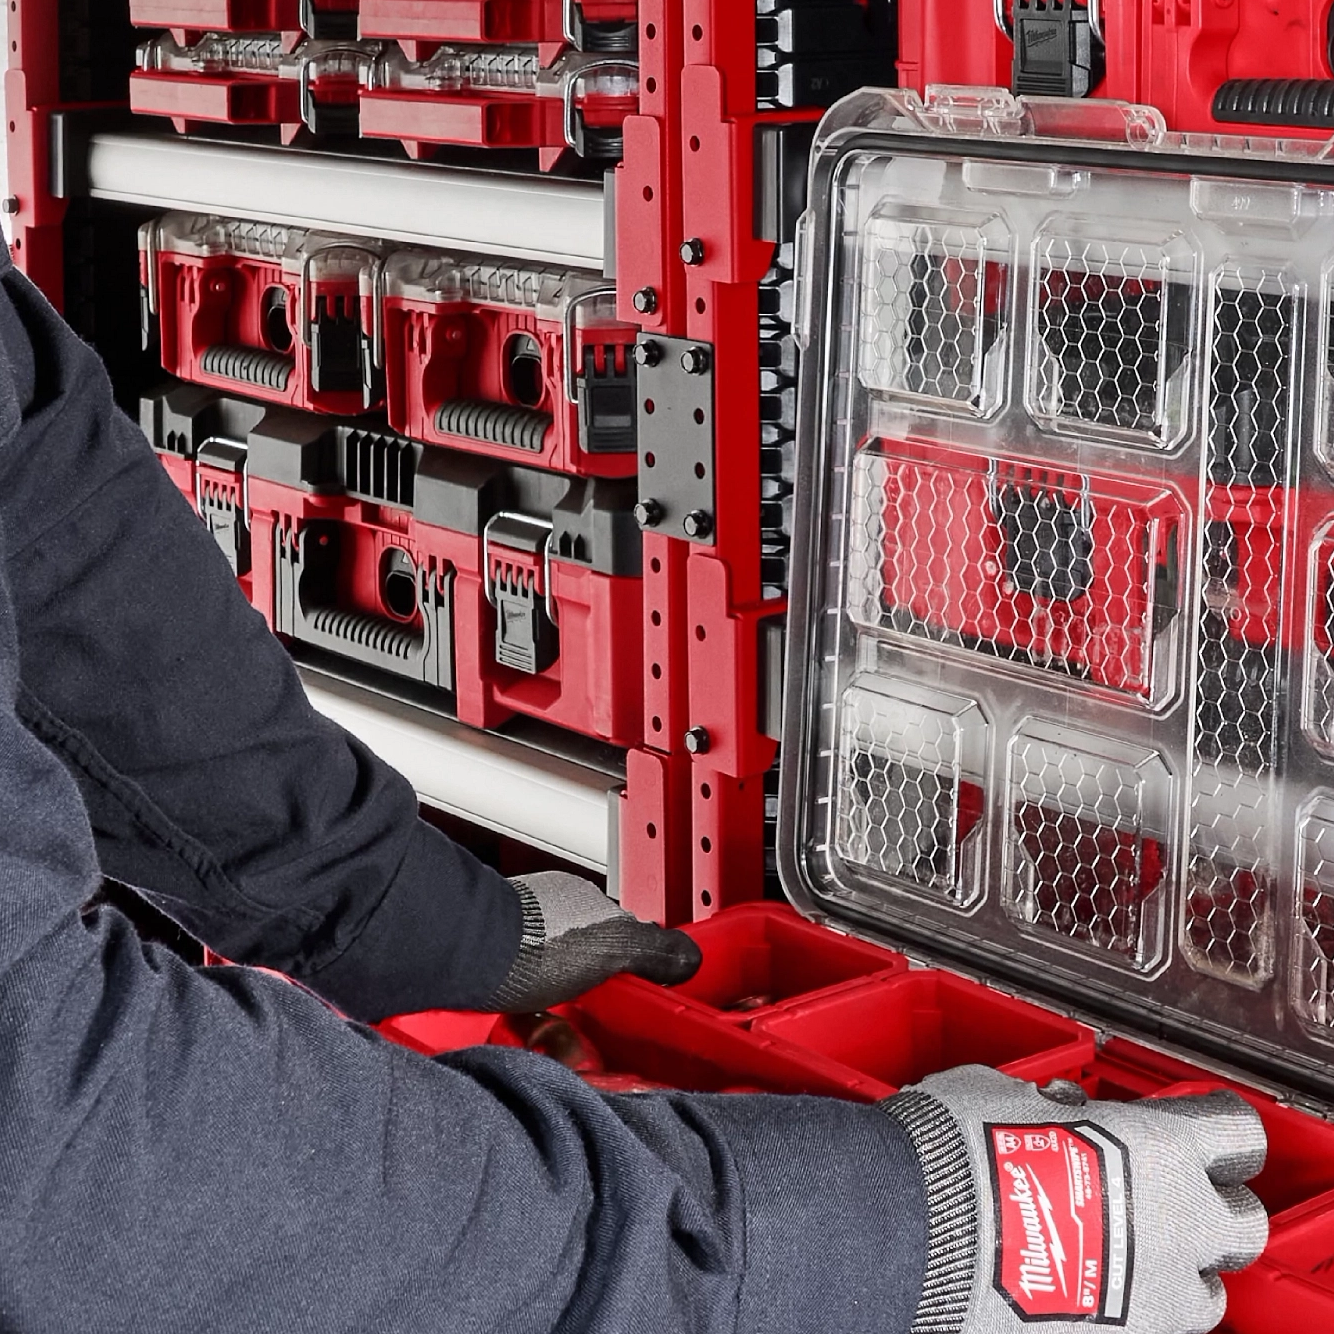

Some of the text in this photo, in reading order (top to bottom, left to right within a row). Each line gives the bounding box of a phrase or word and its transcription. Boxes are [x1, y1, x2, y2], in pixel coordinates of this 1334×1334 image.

[1111, 1177, 1124, 1290] CUT LEVEL 4
